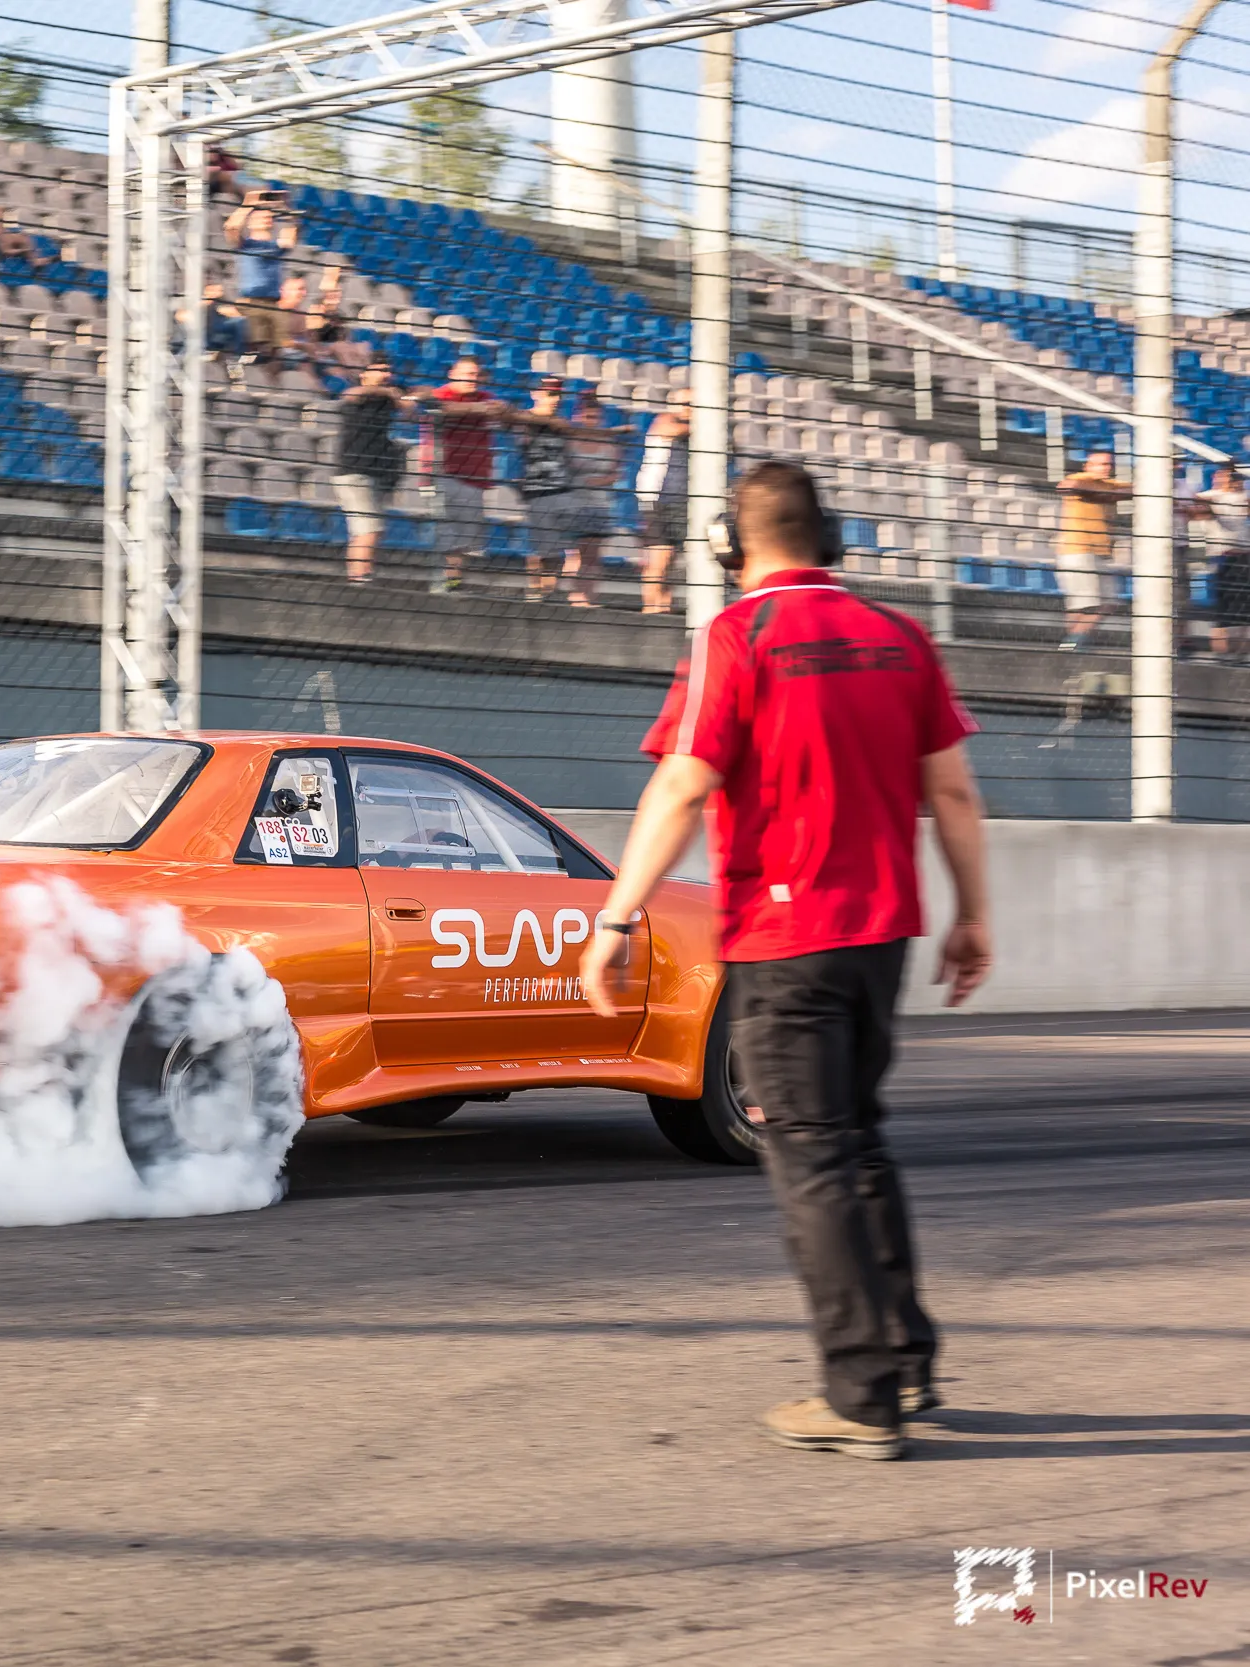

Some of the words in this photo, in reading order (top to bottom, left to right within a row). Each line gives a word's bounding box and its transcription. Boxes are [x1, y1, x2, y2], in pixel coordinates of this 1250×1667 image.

[258, 821, 283, 834] 188
[292, 826, 310, 843] S2
[312, 827, 329, 844] 03
[269, 848, 289, 858] AS2
[483, 977, 590, 1003] PERFORMANCE
